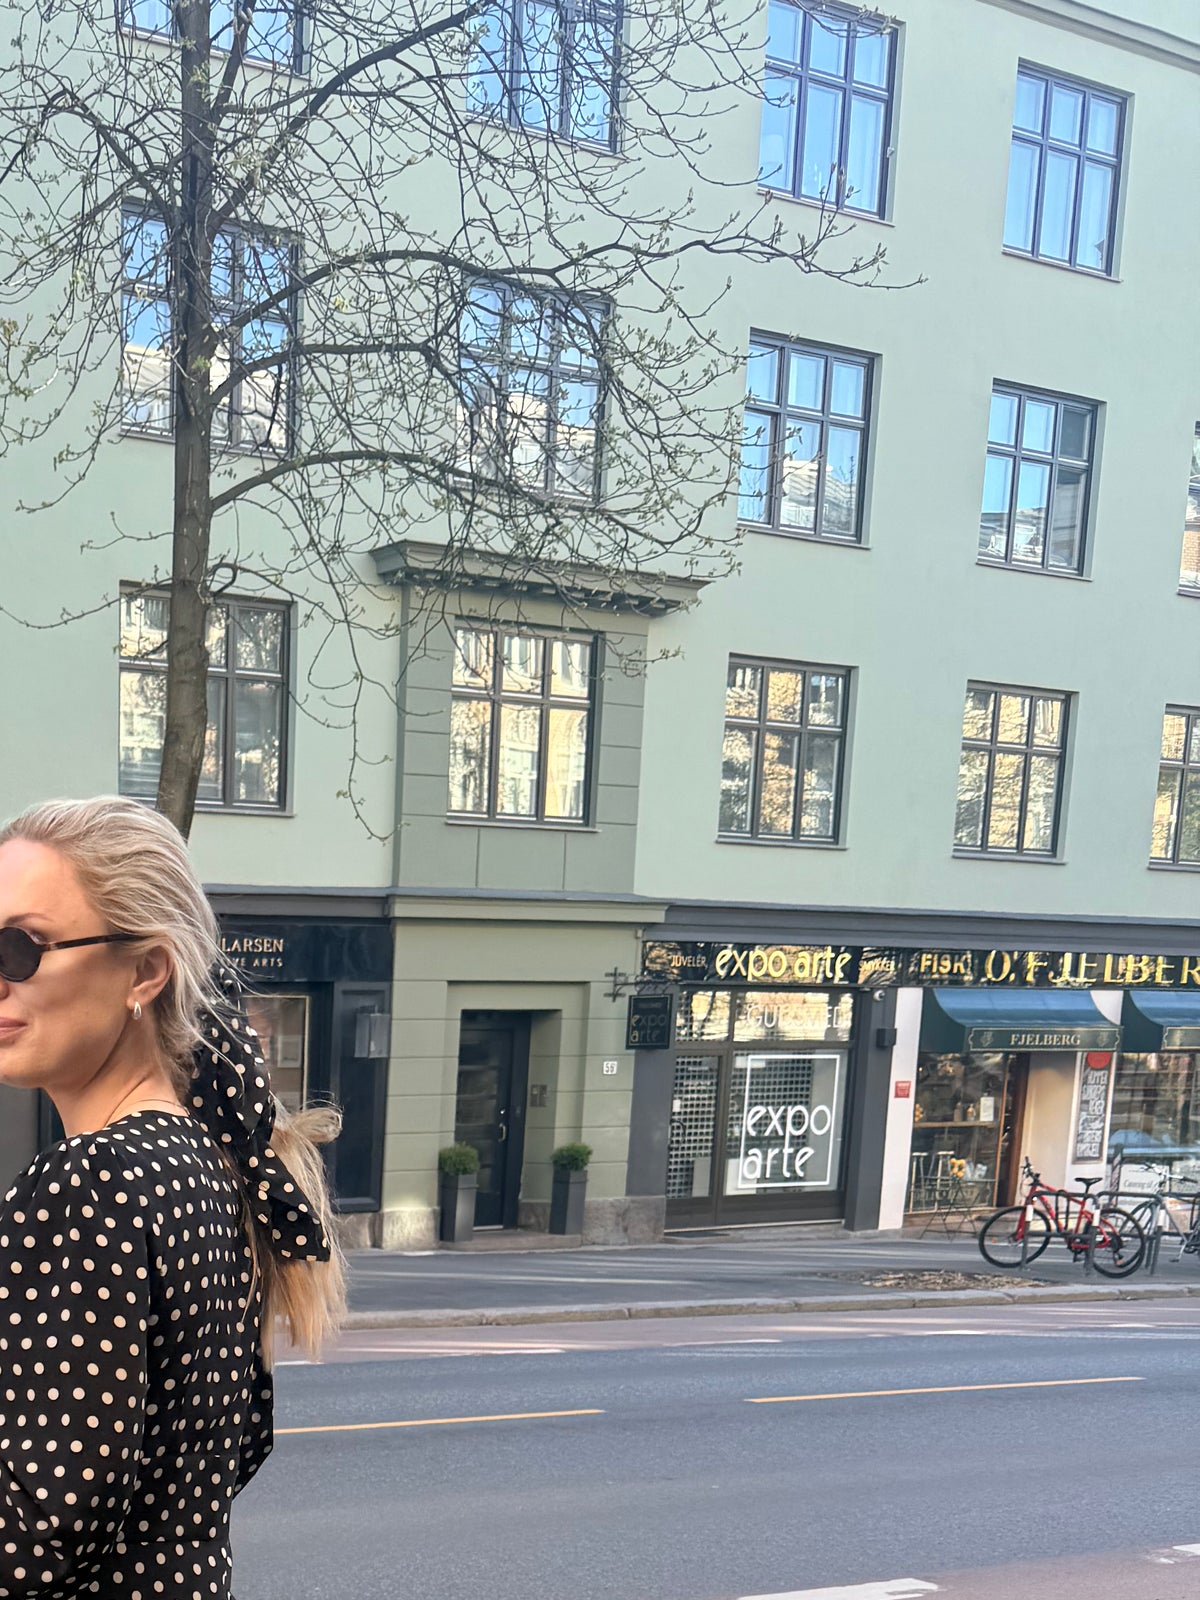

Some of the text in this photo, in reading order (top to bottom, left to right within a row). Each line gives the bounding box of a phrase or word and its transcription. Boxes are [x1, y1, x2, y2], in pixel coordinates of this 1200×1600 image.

[221, 937, 284, 953] LARSEN
[252, 957, 284, 968] ARTS
[715, 945, 852, 982] expo arte
[1010, 1033, 1081, 1047] FJELBERG
[746, 1104, 832, 1149] expo
[742, 1146, 815, 1179] arte
